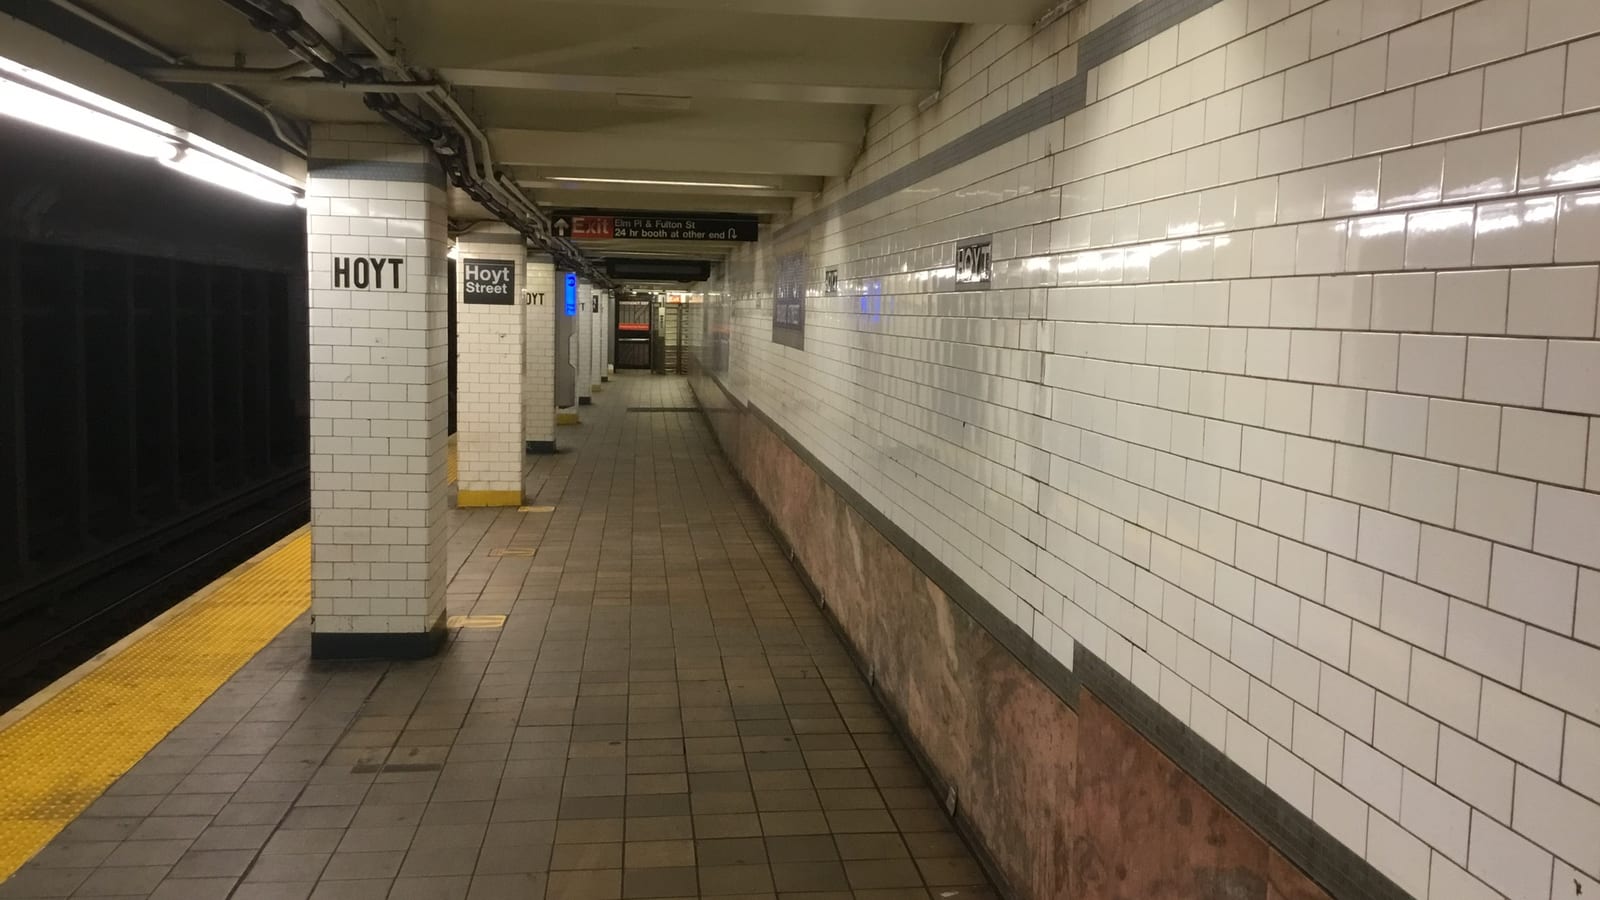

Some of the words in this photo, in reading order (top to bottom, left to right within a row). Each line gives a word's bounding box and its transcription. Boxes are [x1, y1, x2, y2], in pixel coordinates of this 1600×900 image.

[573, 217, 609, 234] Exit
[615, 219, 631, 228] Elm
[645, 220, 652, 228] &
[655, 220, 682, 229] Fulton
[685, 221, 695, 229] St
[615, 228, 626, 237] 24
[629, 229, 638, 237] hr
[641, 229, 667, 238] booth
[670, 230, 679, 238] at
[682, 230, 705, 239] other
[708, 231, 725, 239] end
[956, 244, 991, 282] HOYT
[334, 256, 404, 289] HOYT
[465, 264, 510, 284] Hoyt
[465, 281, 508, 294] Street
[526, 292, 545, 305] OYT
